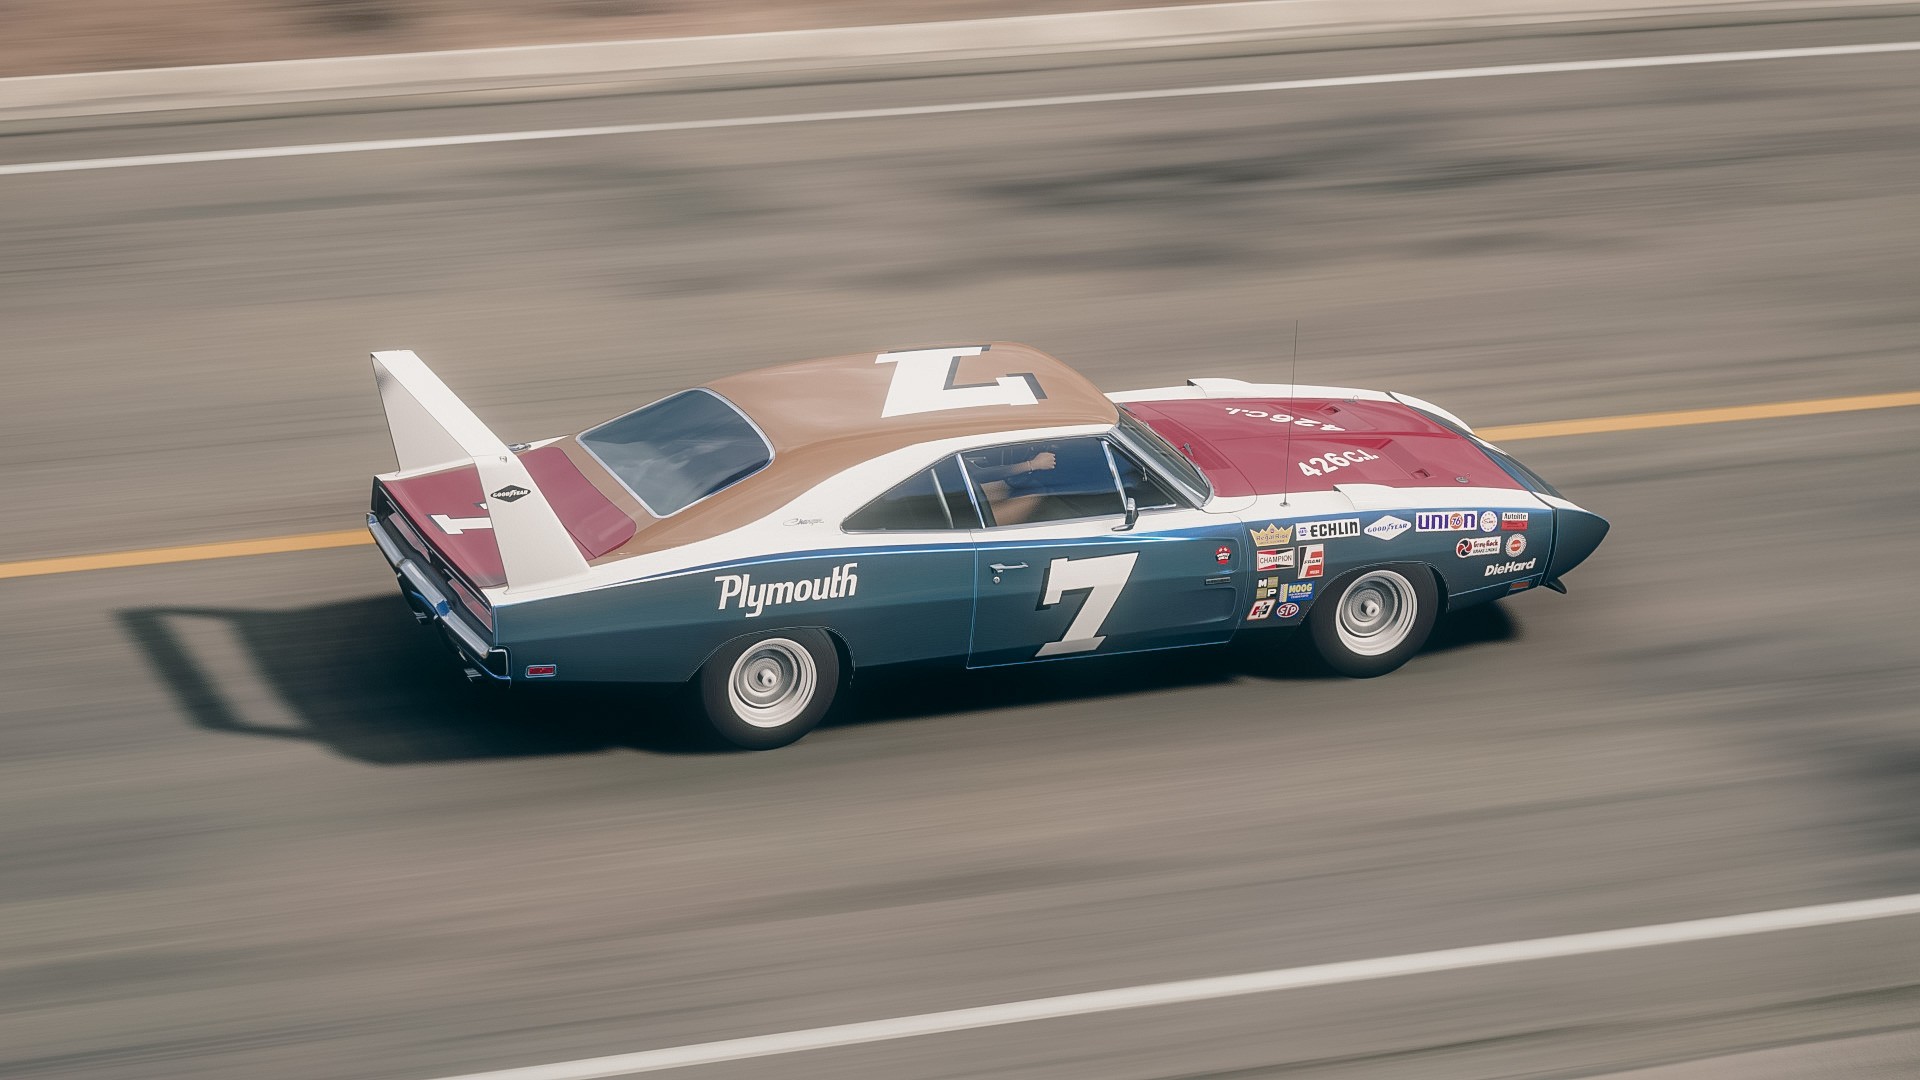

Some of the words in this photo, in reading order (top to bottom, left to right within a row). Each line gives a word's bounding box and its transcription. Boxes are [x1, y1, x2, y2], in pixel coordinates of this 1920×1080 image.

[492, 489, 529, 498] GOODYEAR
[1310, 521, 1359, 537] ECHLIN
[1367, 522, 1408, 534] GOODYEAR
[1259, 554, 1293, 565] CHAMPION
[1484, 558, 1537, 577] DieHard
[714, 562, 858, 618] Plymouth
[1288, 583, 1313, 594] MOOG
[1035, 550, 1140, 658] 7
[1279, 604, 1298, 617] STP
